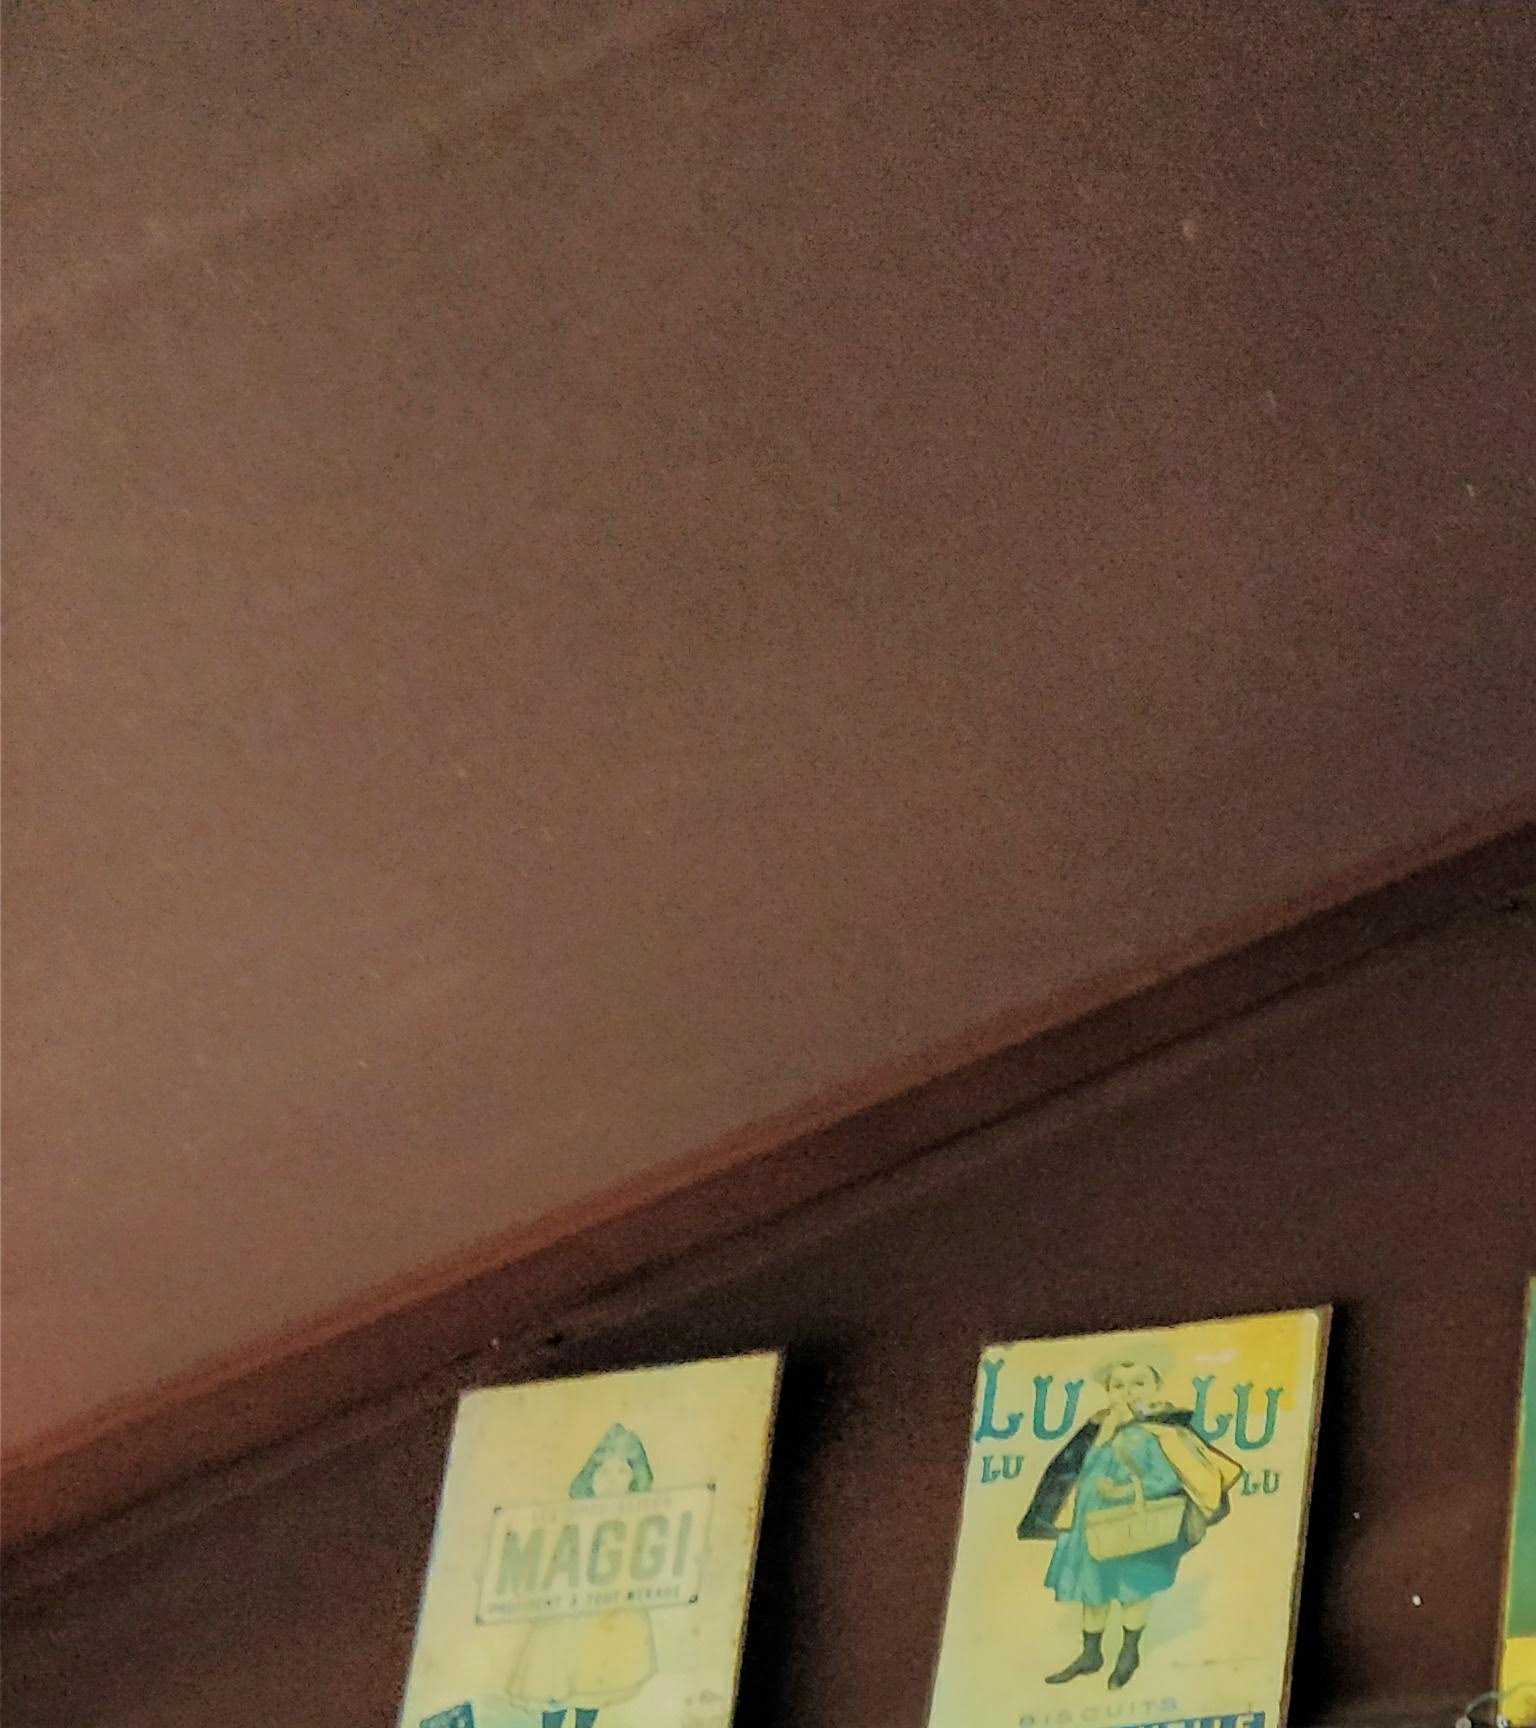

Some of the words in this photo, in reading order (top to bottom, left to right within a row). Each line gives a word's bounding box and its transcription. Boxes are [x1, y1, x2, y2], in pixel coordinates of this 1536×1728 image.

[974, 1357, 1085, 1443] LU
[1191, 1374, 1283, 1451] LU
[981, 1454, 1024, 1484] LU
[1241, 1469, 1281, 1497] LU
[496, 1510, 692, 1597] MAGGI
